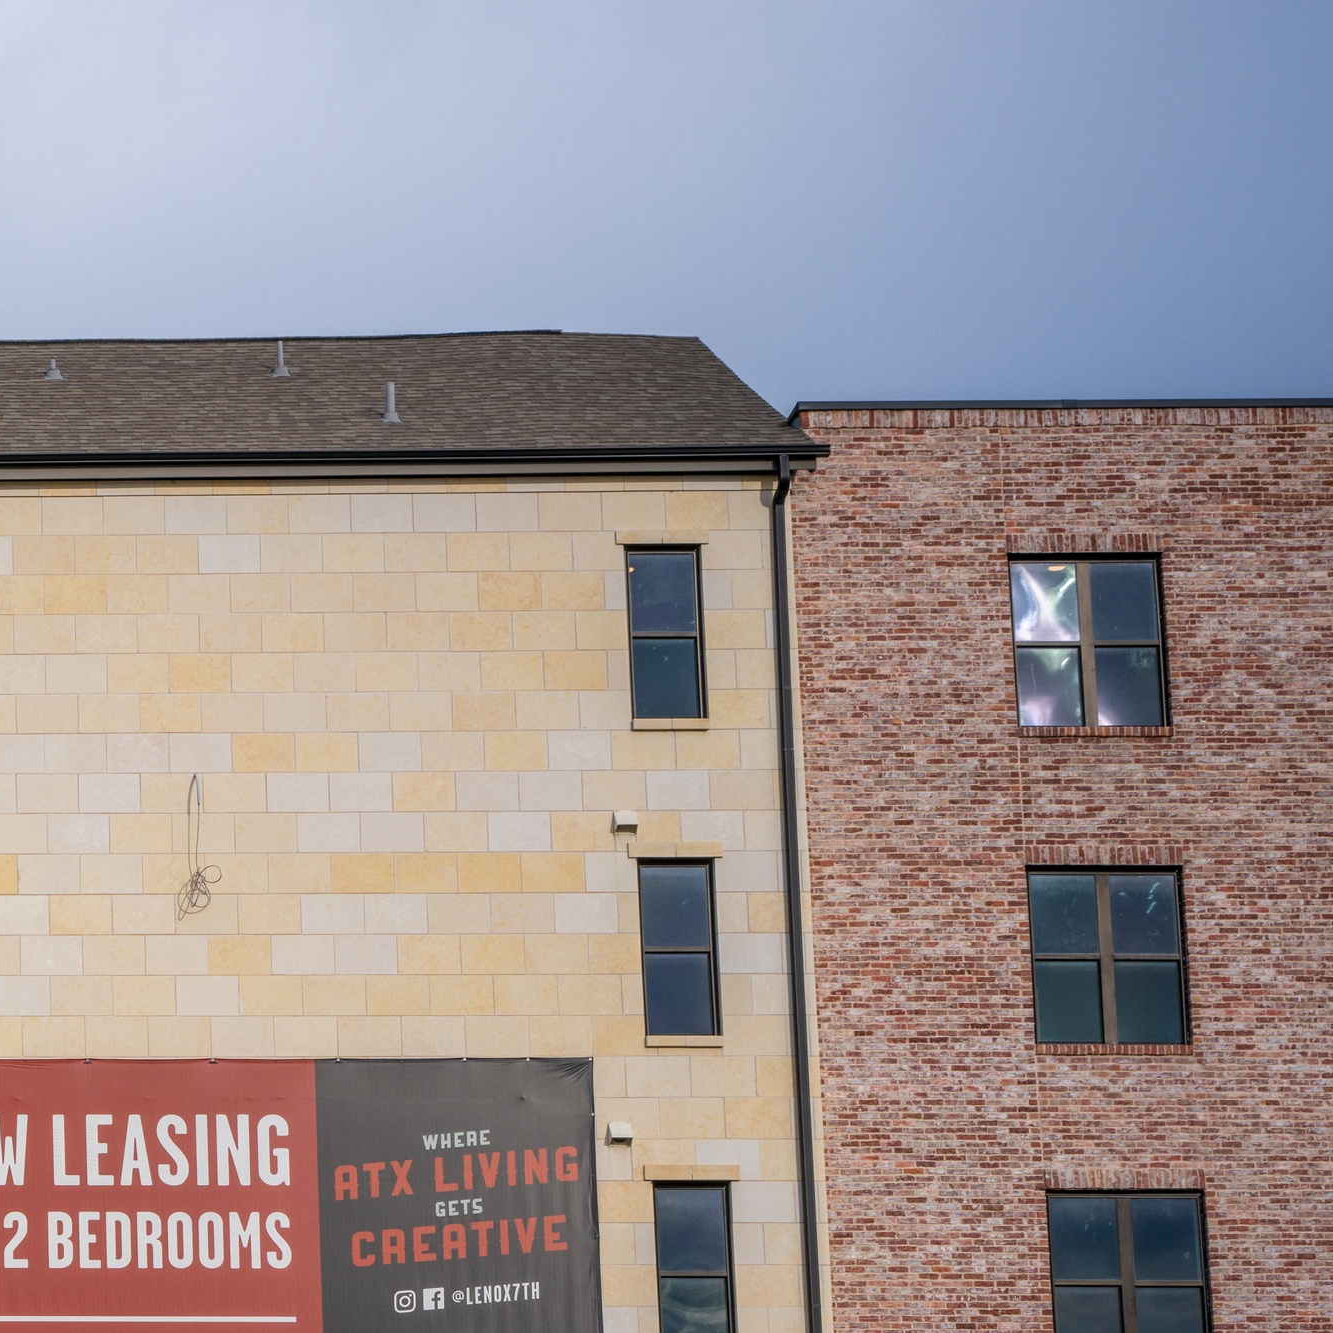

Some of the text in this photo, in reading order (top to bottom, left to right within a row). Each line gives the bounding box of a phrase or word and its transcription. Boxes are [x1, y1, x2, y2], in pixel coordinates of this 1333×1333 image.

[52, 1113, 291, 1187] LEASING
[421, 1129, 491, 1151] WHERE
[334, 1145, 580, 1202] ATX LIVING
[434, 1197, 484, 1218] GETS
[3, 1211, 29, 1269] 2
[47, 1211, 293, 1270] BEDROOMS
[351, 1213, 569, 1268] CREATIVE
[451, 1281, 541, 1305] @LENOX7TH
